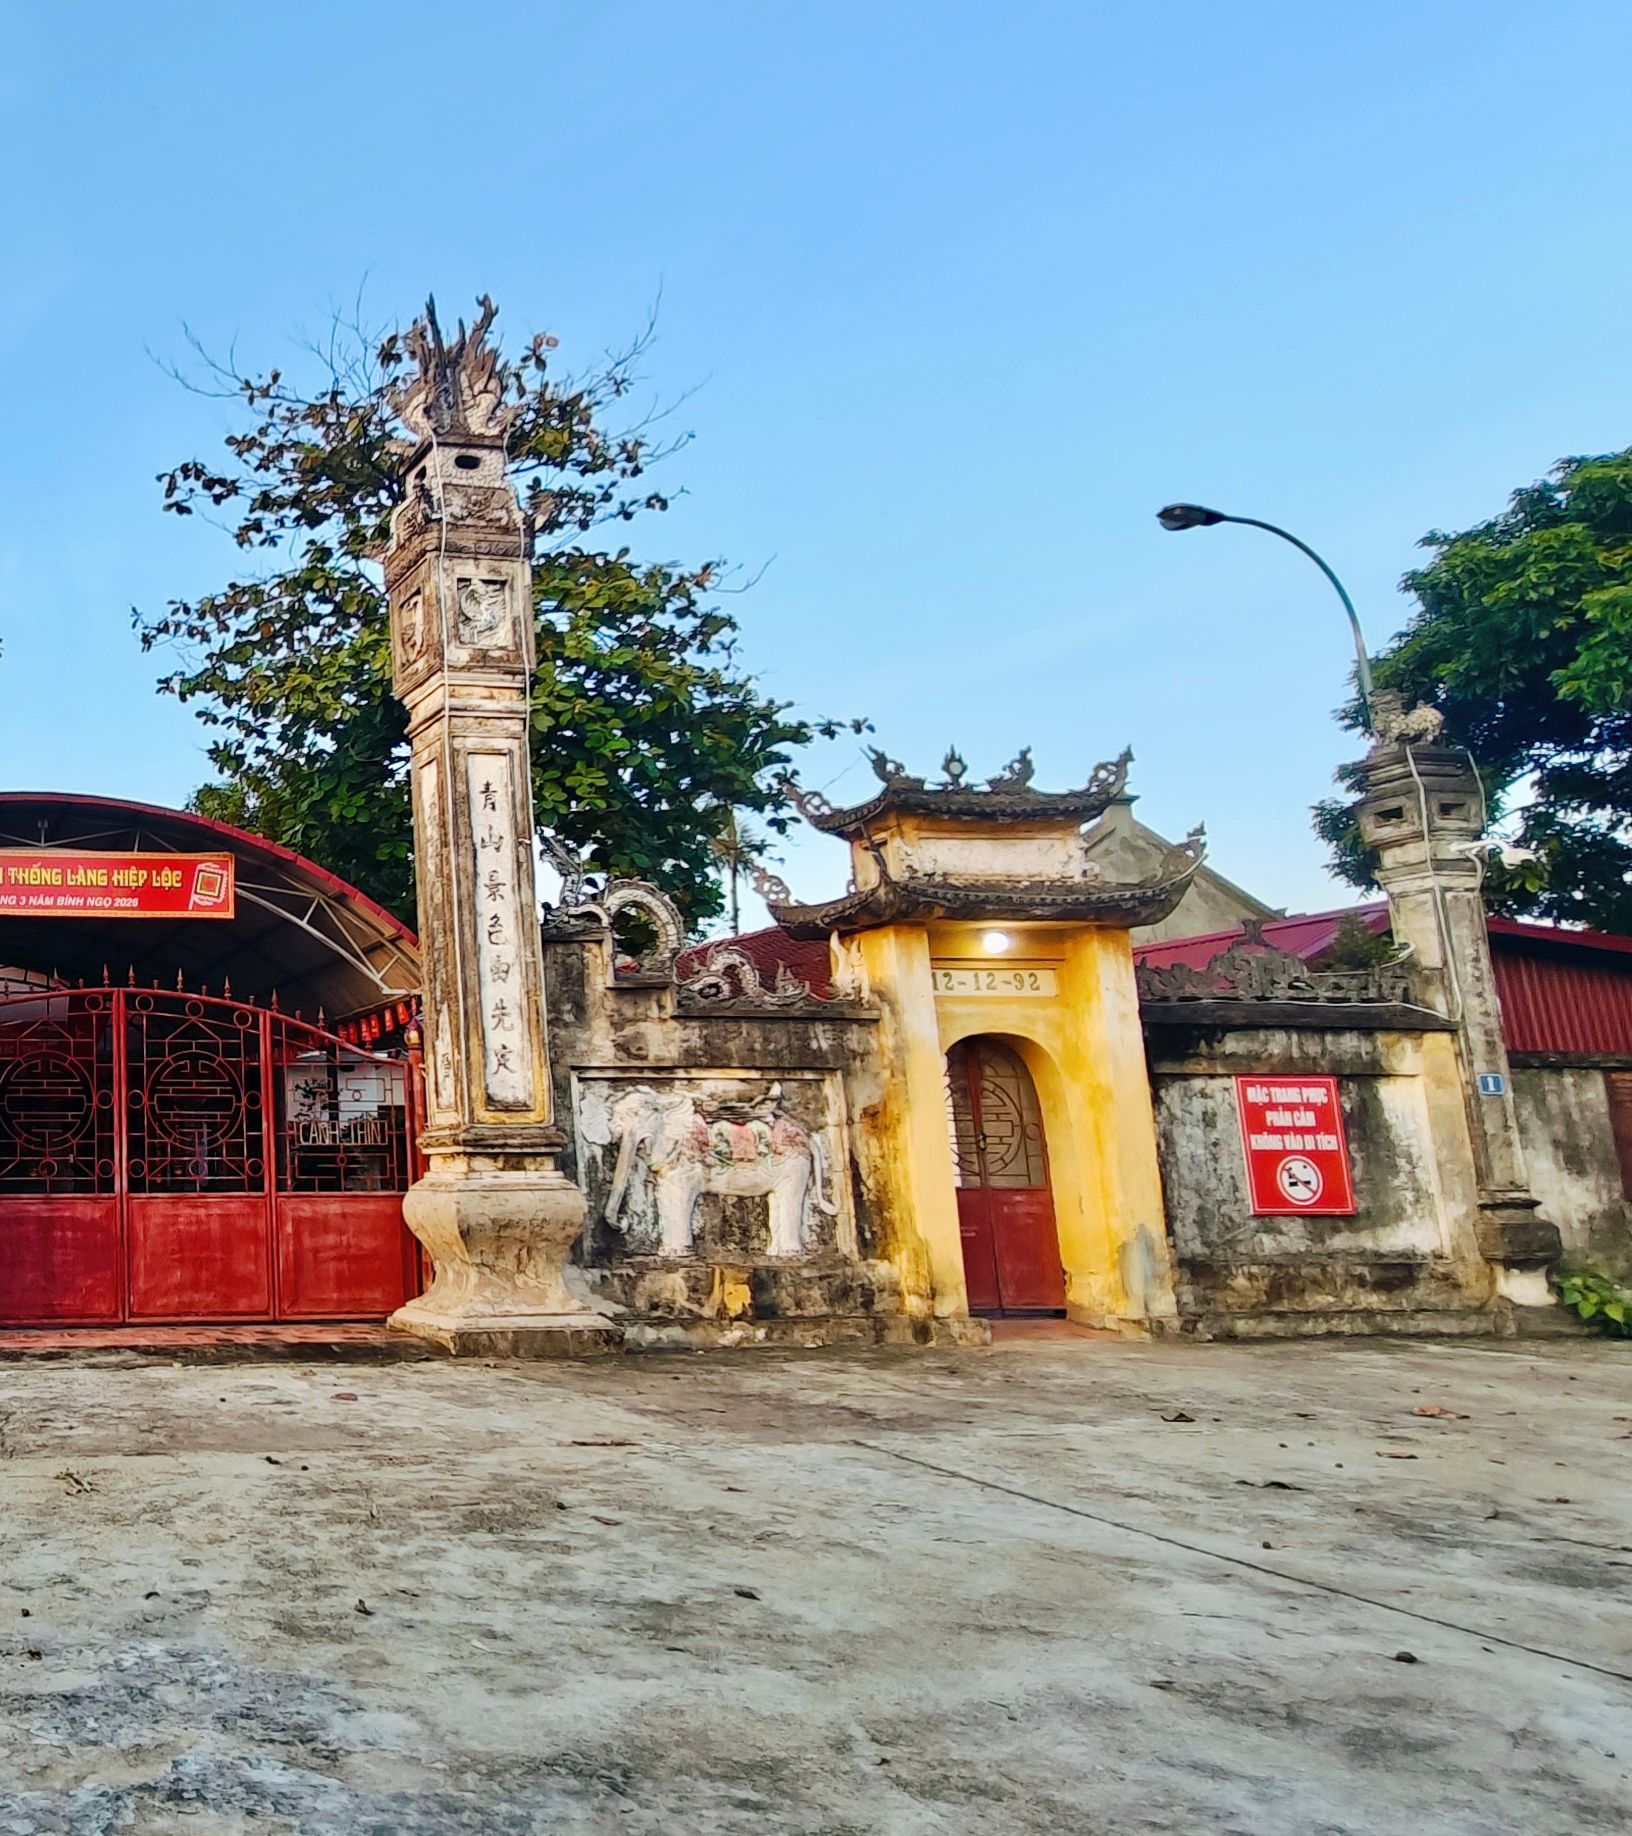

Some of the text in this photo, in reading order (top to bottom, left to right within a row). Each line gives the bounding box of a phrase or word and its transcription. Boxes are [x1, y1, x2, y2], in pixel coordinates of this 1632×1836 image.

[8, 861, 62, 886] THỐNG
[66, 864, 108, 887] LÀNG
[112, 866, 148, 890] HIỆP
[152, 866, 183, 890] LỘC
[19, 895, 26, 906] 3
[28, 894, 53, 906] NĂM
[56, 894, 84, 907] BÍNH
[86, 896, 112, 909] NGỌ
[114, 897, 139, 907] 2026
[1487, 1076, 1497, 1091] 1
